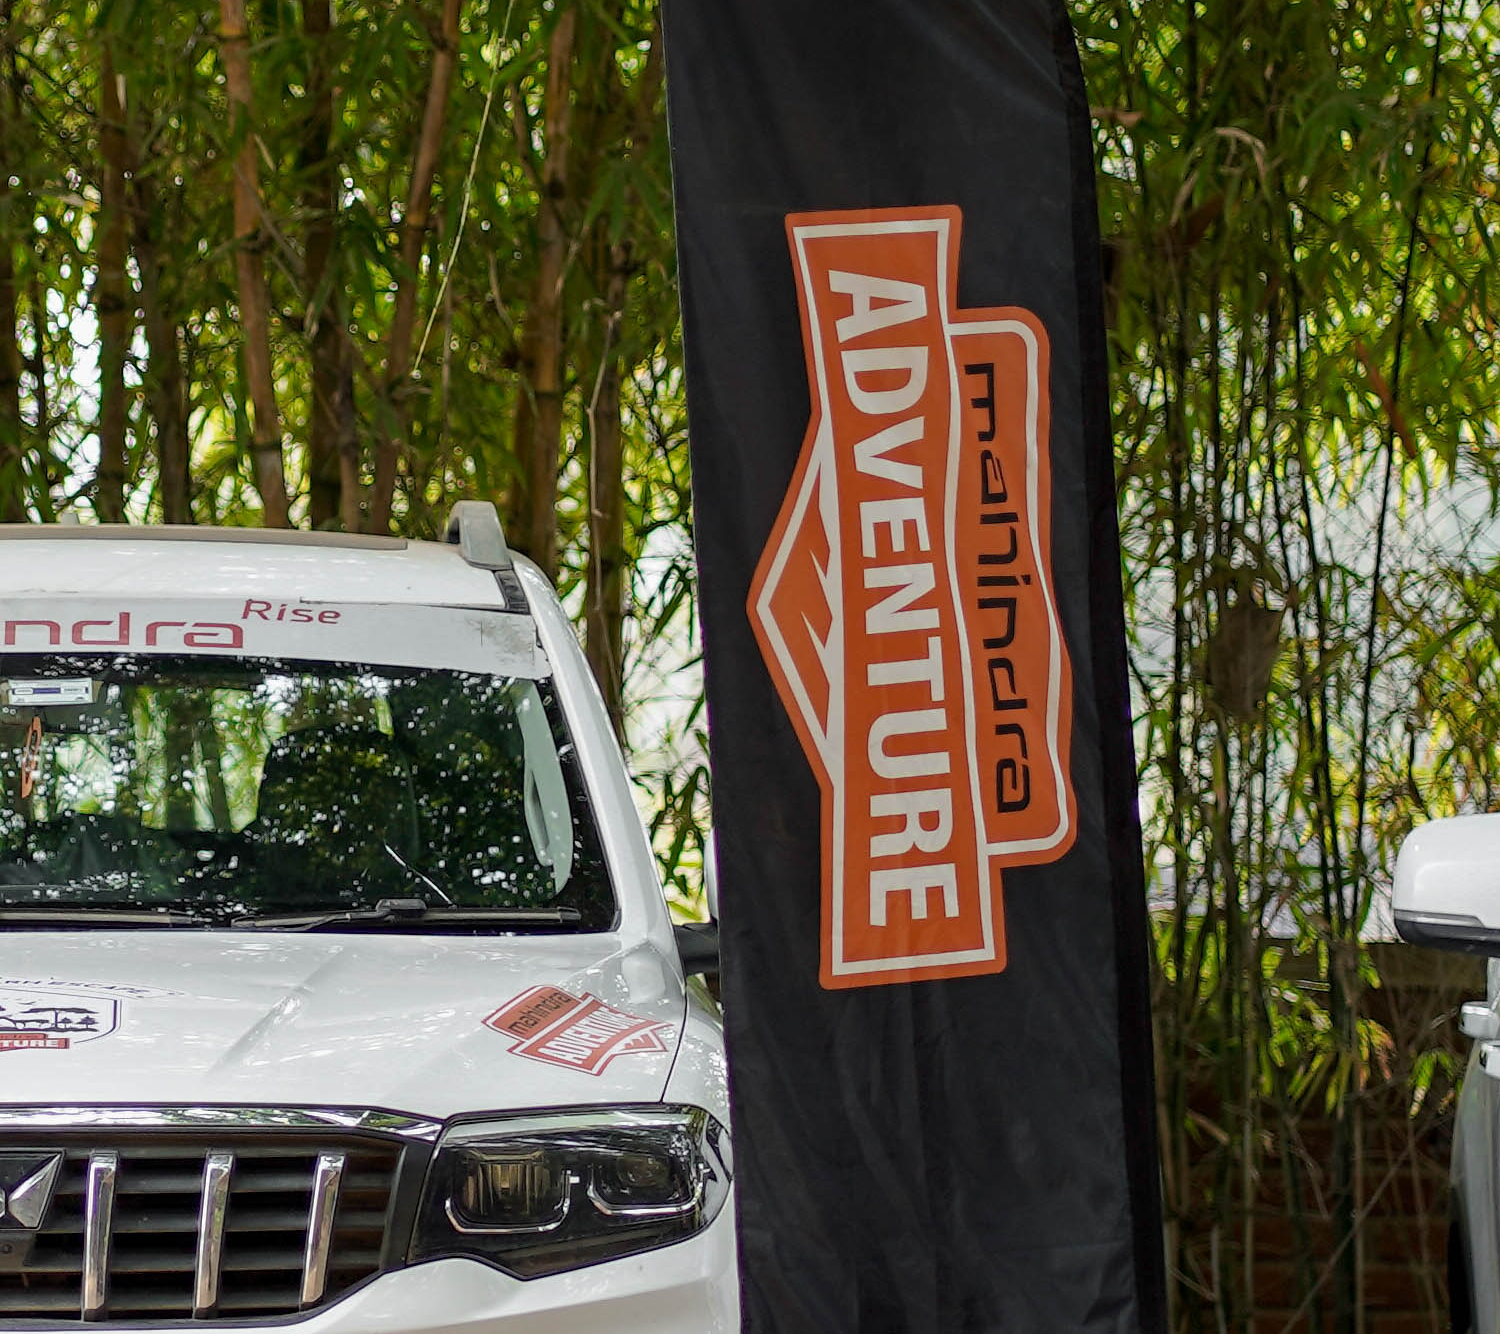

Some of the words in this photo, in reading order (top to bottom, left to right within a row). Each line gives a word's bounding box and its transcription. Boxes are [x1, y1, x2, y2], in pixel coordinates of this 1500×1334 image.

[241, 599, 342, 626] Rise
[828, 269, 959, 927] ADVENTURE
[964, 362, 1031, 814] mahindra
[508, 990, 574, 1036] mahindra
[536, 1006, 648, 1065] ADVENTURE
